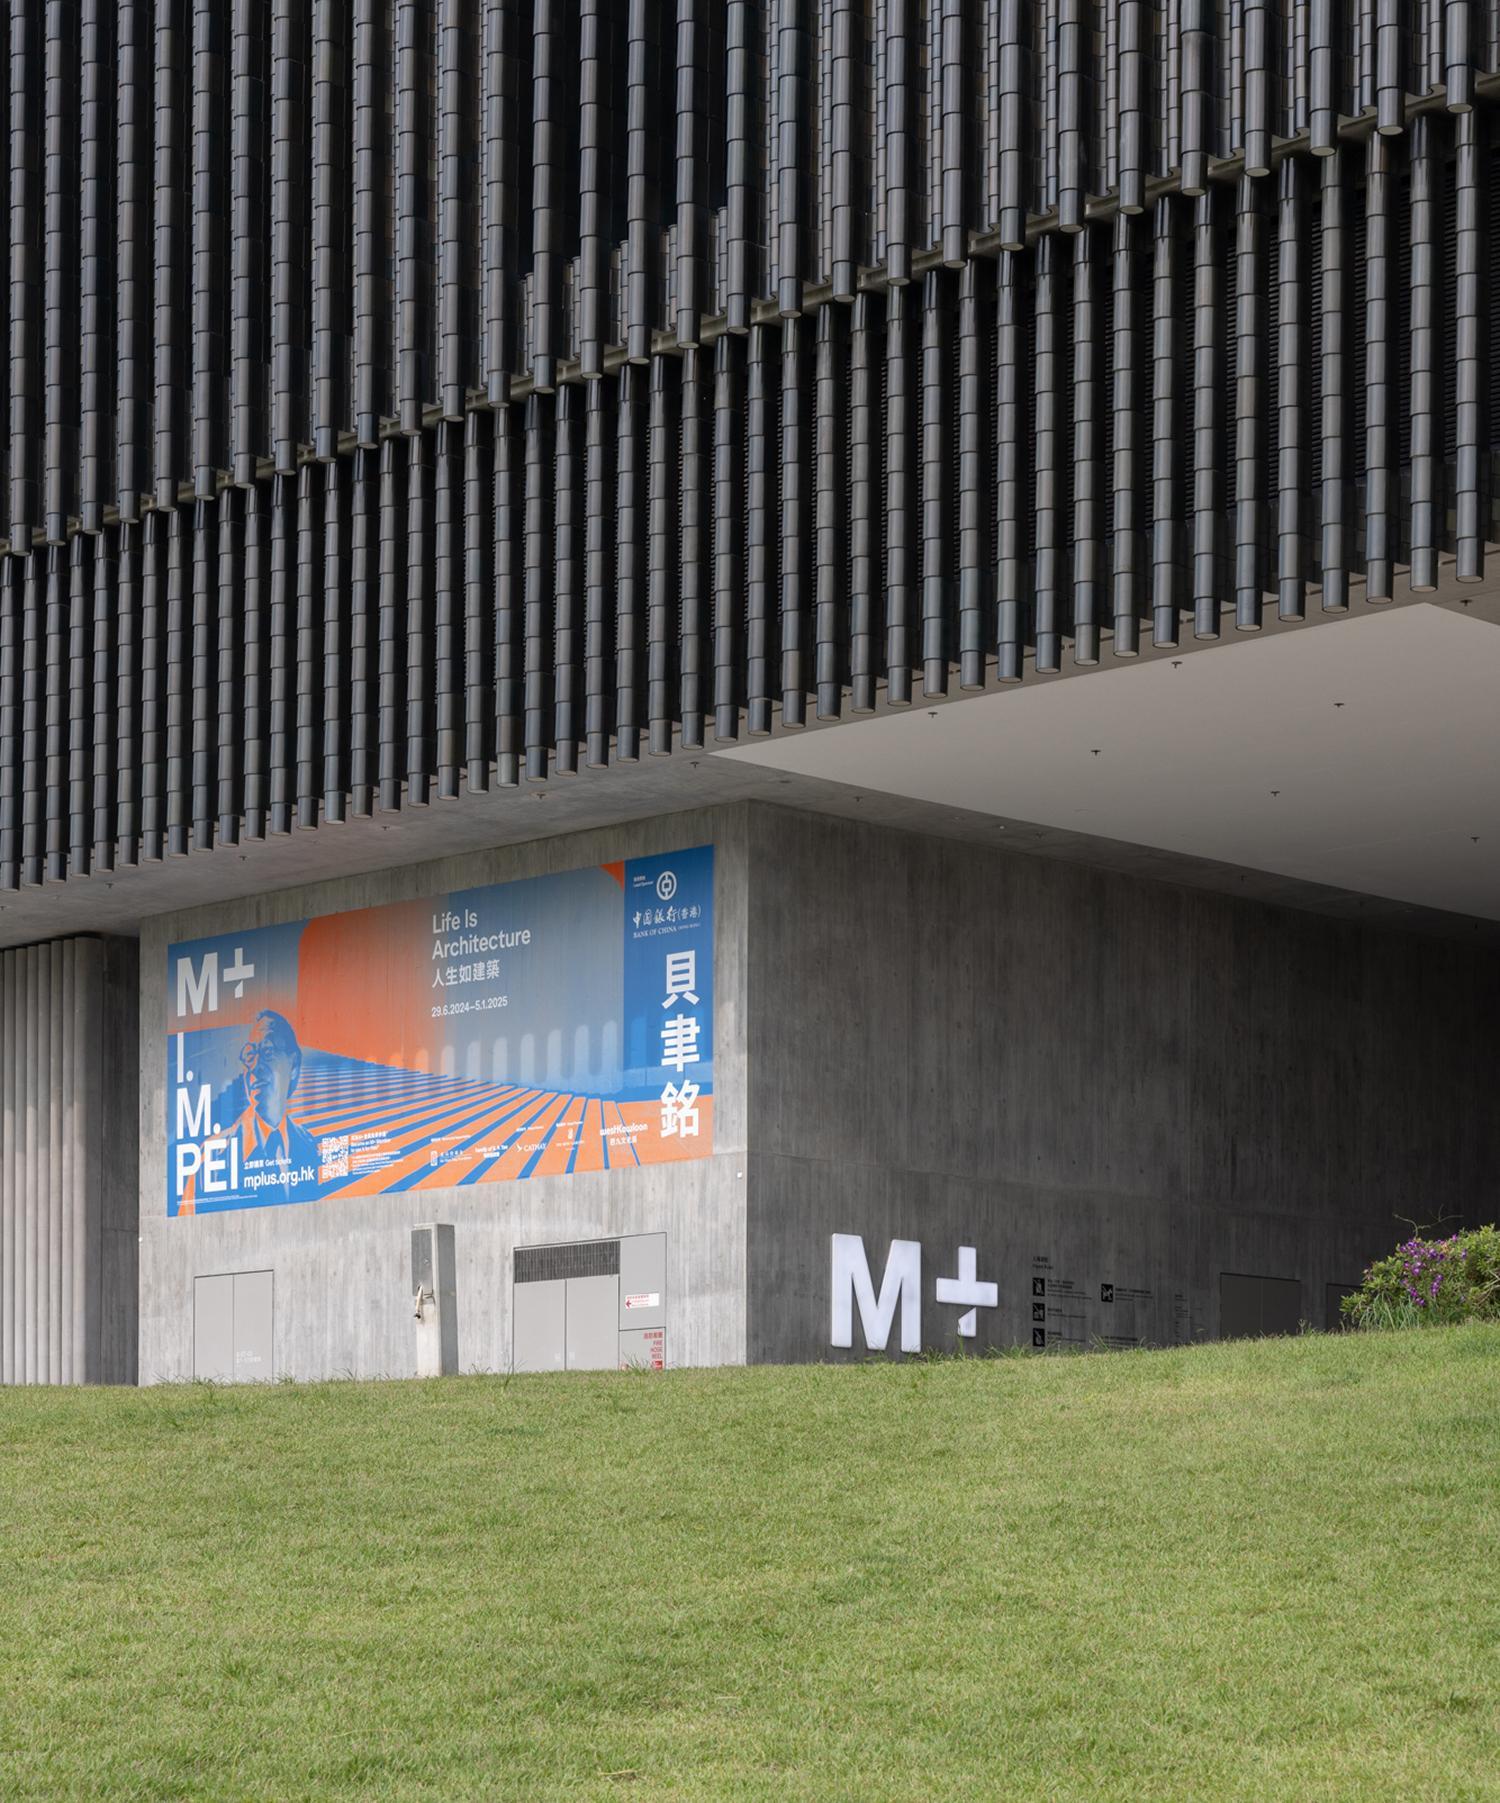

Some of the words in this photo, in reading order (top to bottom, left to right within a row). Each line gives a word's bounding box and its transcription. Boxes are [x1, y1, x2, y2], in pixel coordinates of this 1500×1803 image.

[432, 913, 460, 935] Life
[464, 908, 478, 929] Is
[432, 928, 532, 960] Architecture
[649, 928, 657, 936] OF
[658, 926, 677, 935] CHINA
[176, 947, 254, 1017] M+
[432, 959, 500, 989] 人生如建築
[176, 1032, 194, 1084] I.
[660, 950, 701, 1138] 貝聿銘
[176, 1084, 220, 1139] M.
[176, 1137, 238, 1196] PEI
[244, 1166, 315, 1191] mplus.org.hk
[832, 1232, 998, 1353] M+
